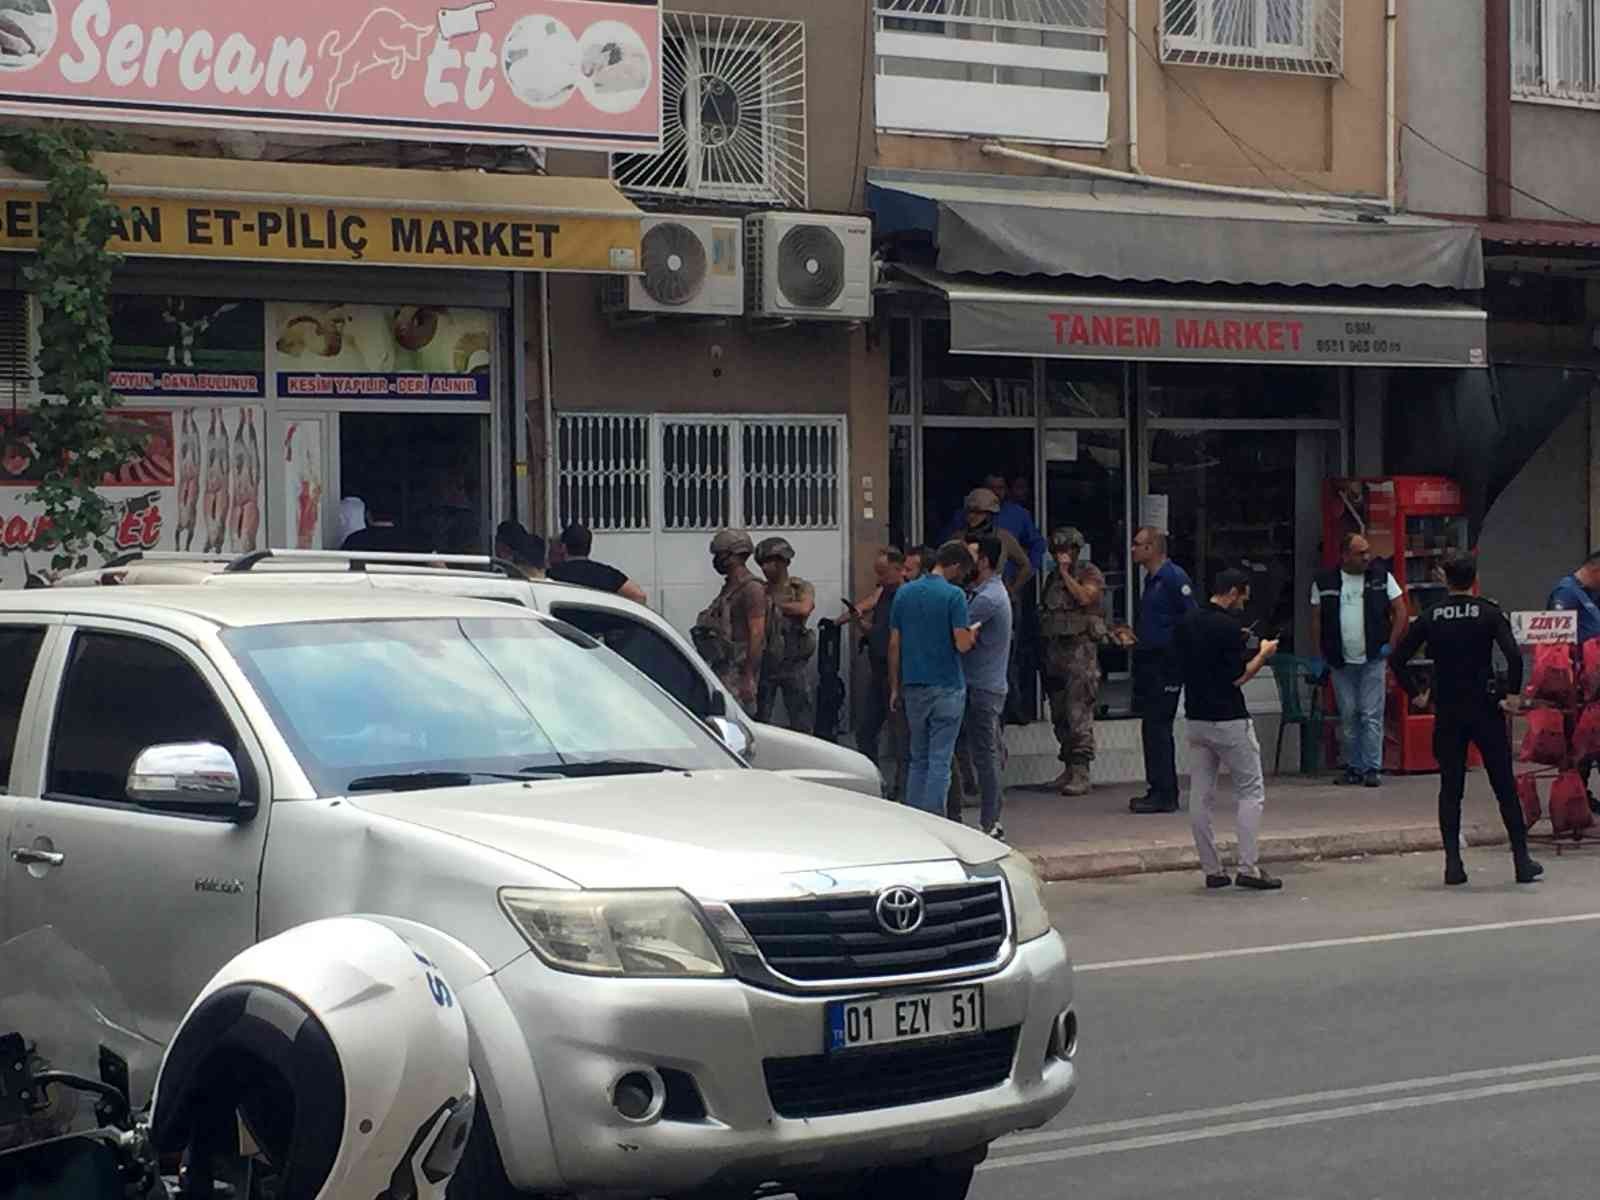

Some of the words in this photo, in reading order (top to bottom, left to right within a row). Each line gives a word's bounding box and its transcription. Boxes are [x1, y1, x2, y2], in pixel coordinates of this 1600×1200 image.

[59, 0, 314, 98] Sercan
[424, 30, 497, 110] Et
[186, 206, 368, 260] ET-PİLİÇ
[391, 216, 561, 259] MARKET
[1048, 314, 1162, 348] TANEM
[1175, 318, 1306, 351] MARKET
[117, 504, 163, 549] Et
[846, 1005, 873, 1043] 01
[895, 996, 931, 1037] EZY
[951, 991, 977, 1029] 51
